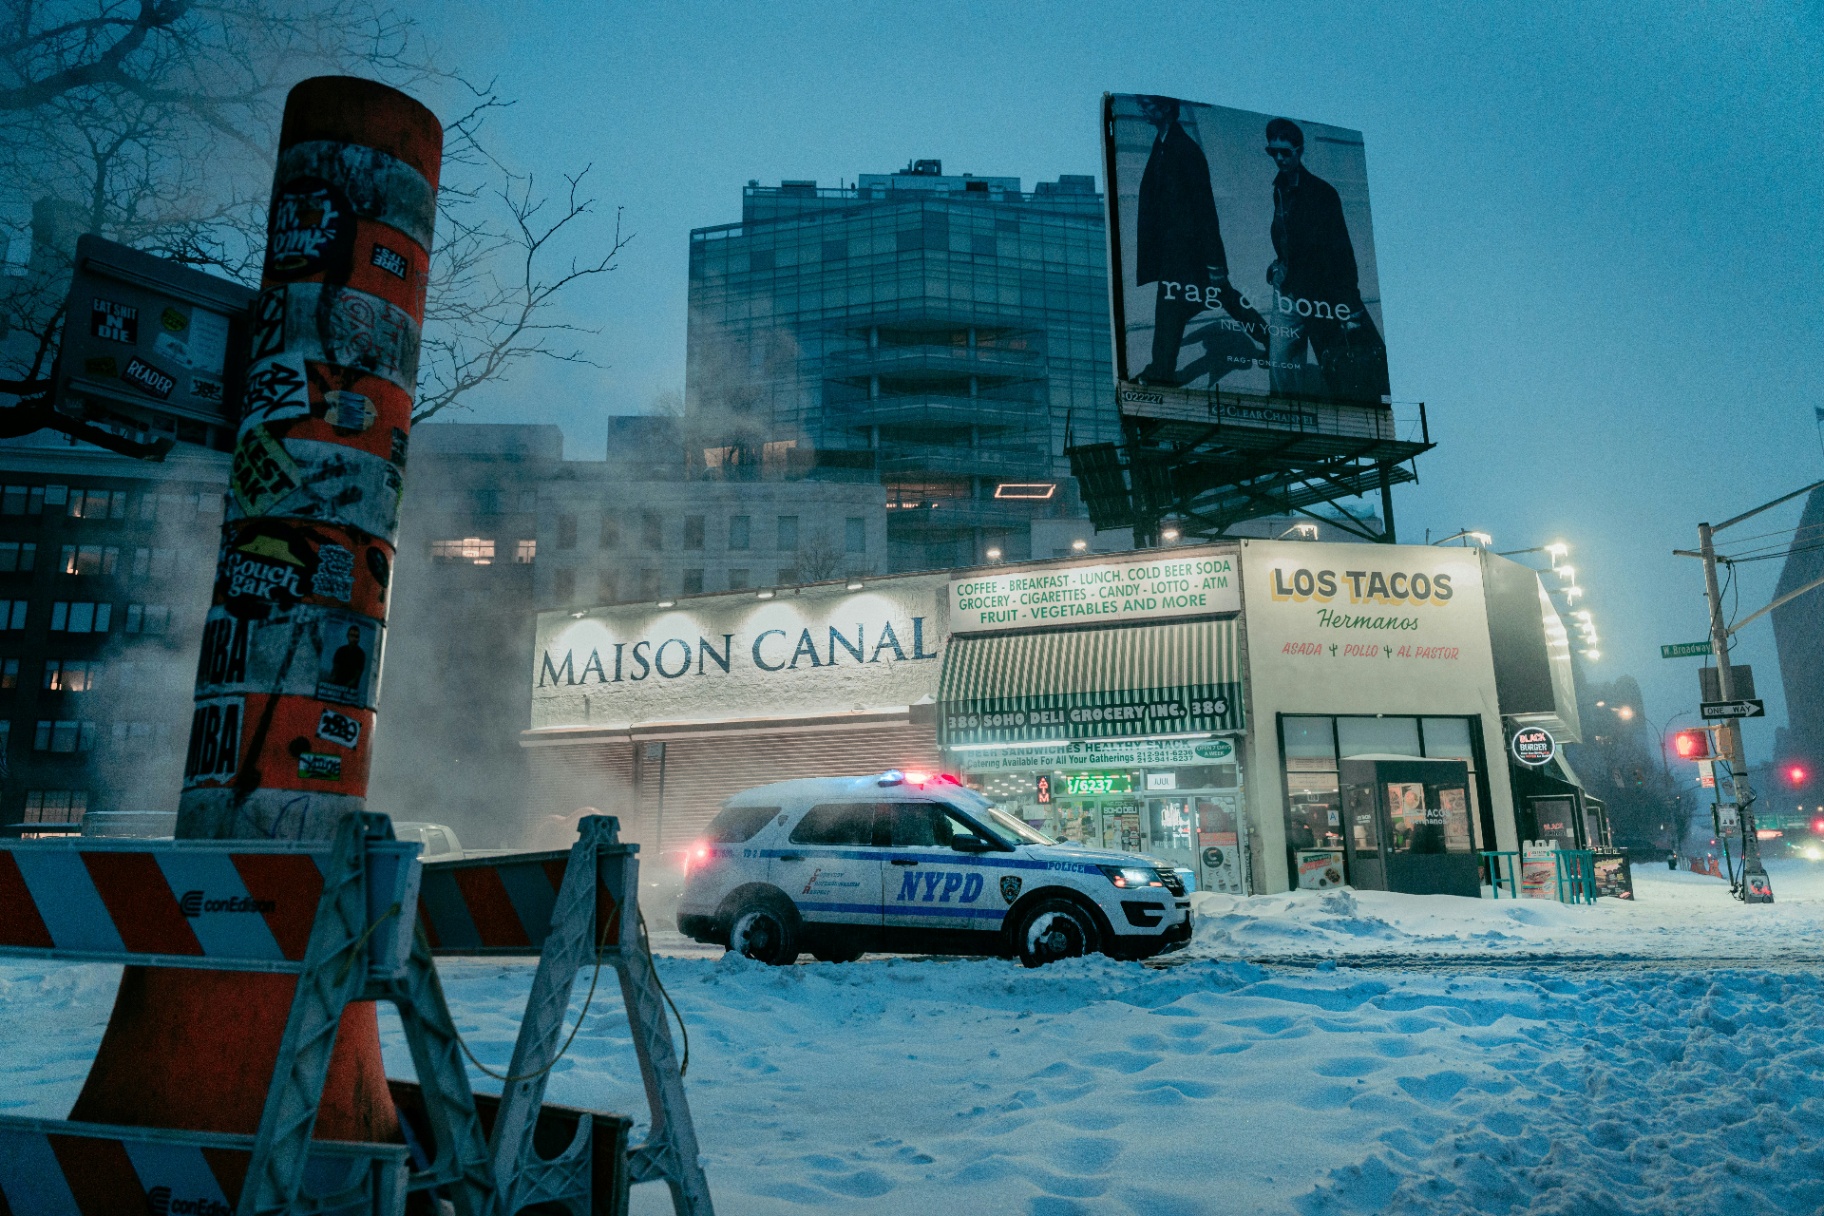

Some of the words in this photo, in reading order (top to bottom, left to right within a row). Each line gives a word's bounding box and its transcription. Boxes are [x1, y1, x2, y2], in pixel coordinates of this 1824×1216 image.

[93, 298, 112, 313] EAT
[115, 302, 137, 320] SHIT
[1162, 280, 1223, 310] rag
[1239, 288, 1259, 309] &
[1275, 290, 1351, 321] bone
[106, 314, 124, 330] N
[1221, 319, 1255, 334] NEW
[1260, 324, 1301, 339] YORK
[98, 325, 130, 343] DIE
[1226, 355, 1301, 370] RAG-BONE.COM
[128, 359, 173, 394] READER
[957, 583, 998, 597] COFFEE
[1009, 575, 1069, 592] BREAKFAST
[1128, 567, 1160, 582] COLD
[1165, 563, 1192, 578] BEER
[1196, 560, 1231, 575] SODA
[1272, 568, 1337, 600] LOS
[1344, 570, 1454, 604] TACOS
[959, 594, 1010, 611] GROCERY
[1020, 589, 1086, 605] CIGARETTES
[1099, 584, 1140, 600] CANDY
[1151, 579, 1190, 595] LOTTO
[1202, 576, 1229, 590] ATM
[980, 609, 1017, 624] FRUIT
[1031, 600, 1118, 620] VEGETABLES
[1123, 597, 1157, 612] AND
[1162, 594, 1207, 609] MORE
[1317, 608, 1419, 630] Hermanos
[537, 634, 734, 688] MAISON
[751, 617, 938, 672] CANAL
[1281, 642, 1323, 656] ASADA
[1343, 644, 1379, 657] POLLO
[1396, 645, 1412, 658] AL
[1415, 647, 1460, 660] PASTOR
[1674, 643, 1711, 655] Broadway
[948, 714, 978, 729] 386
[983, 712, 1025, 728] SOHO
[1030, 710, 1065, 725] DELI
[1070, 706, 1145, 722] GROCERY
[1150, 703, 1186, 718] INC.
[1191, 700, 1226, 715] 386
[1707, 707, 1725, 715] ONE
[1732, 704, 1751, 714] WAY
[1519, 732, 1547, 743] BLACK
[1520, 743, 1548, 751] BURGER
[968, 759, 1000, 769] Catering
[1002, 757, 1038, 767] Available
[1040, 756, 1054, 765] For
[1055, 755, 1067, 764] All
[1068, 753, 1087, 764] Your
[1089, 753, 1134, 764] Gatherings
[1136, 755, 1194, 763] 212-941-6237
[1038, 777, 1050, 803] ATM
[1048, 861, 1085, 873] POLICE
[896, 870, 984, 904] NYPD
